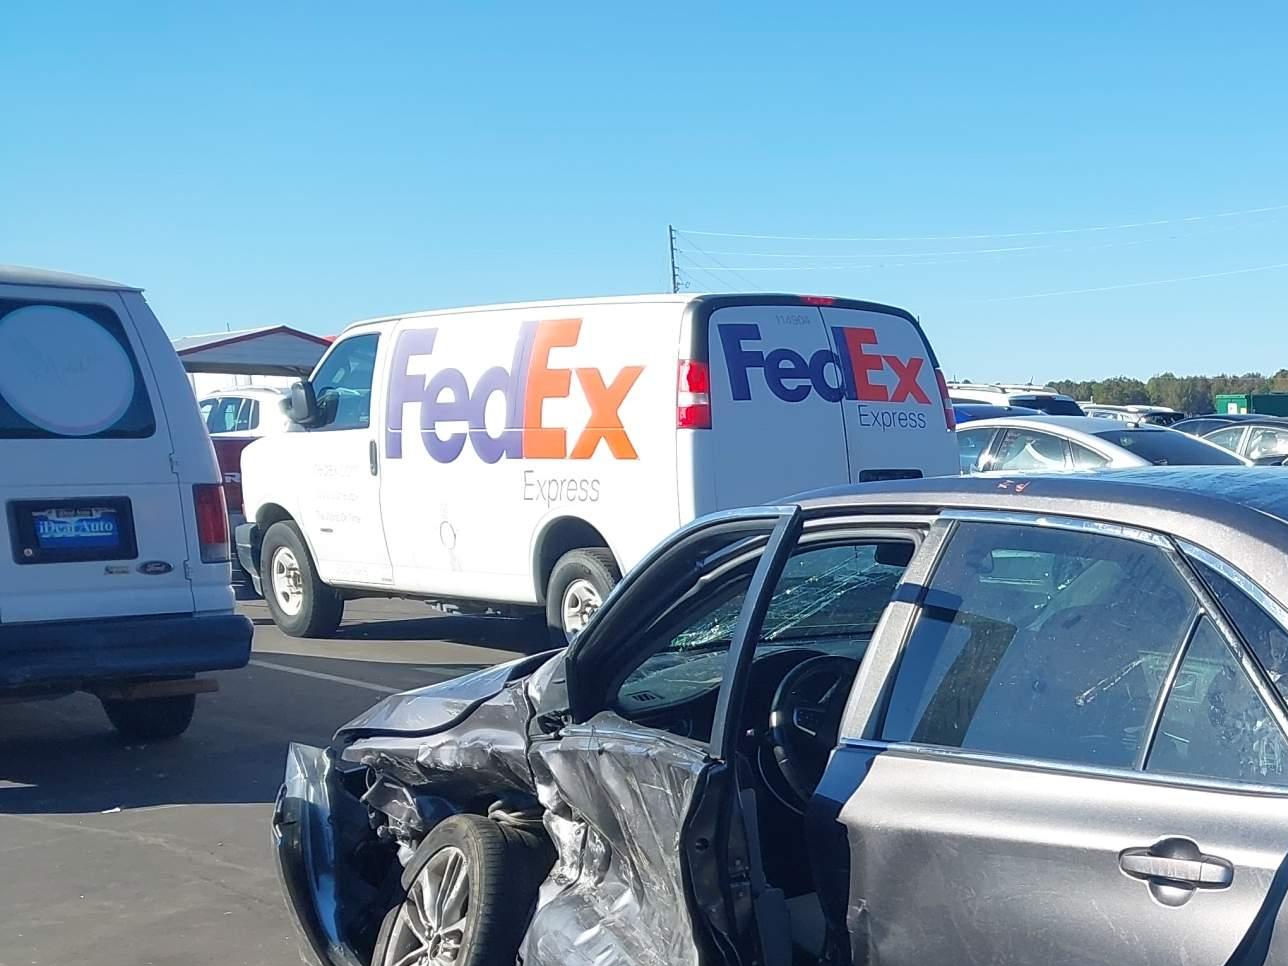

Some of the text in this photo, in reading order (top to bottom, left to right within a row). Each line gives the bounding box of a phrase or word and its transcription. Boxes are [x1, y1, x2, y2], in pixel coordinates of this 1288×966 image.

[717, 323, 932, 405] FedEx
[385, 318, 647, 464] FedEx
[857, 405, 926, 432] Express
[523, 470, 600, 508] Express
[79, 520, 113, 532] Auto
